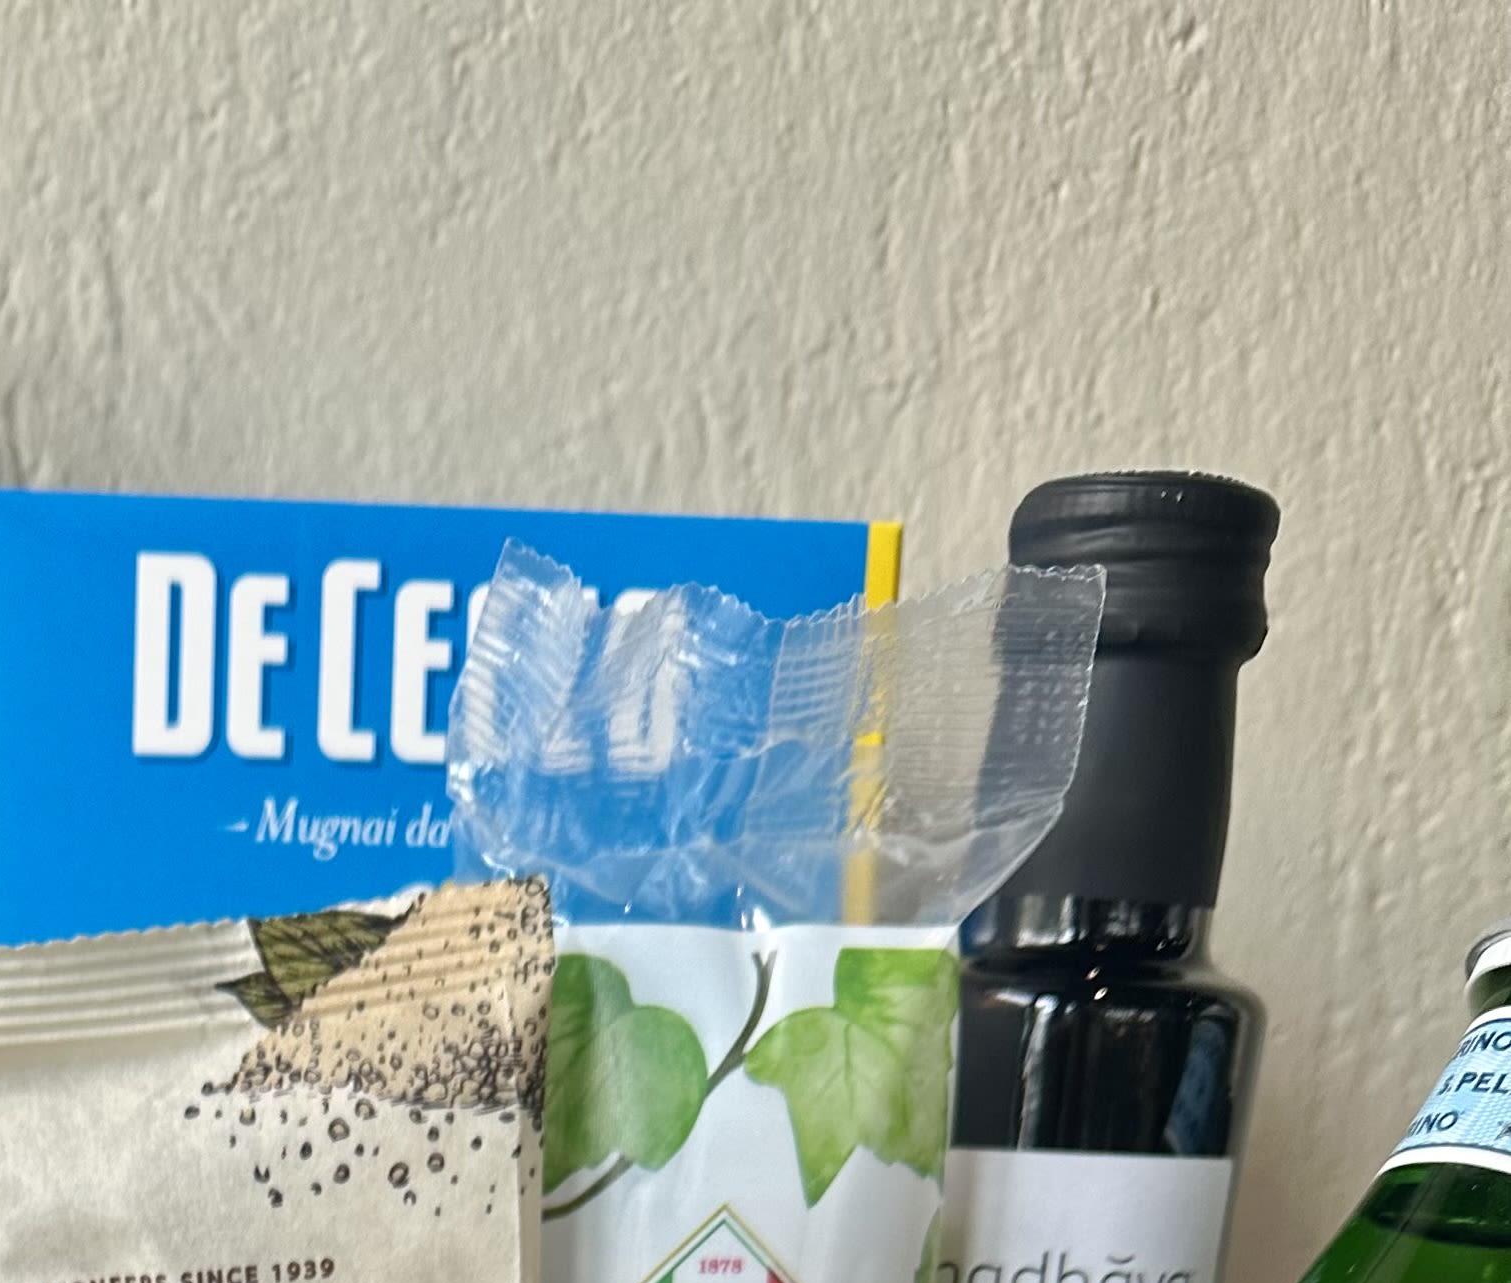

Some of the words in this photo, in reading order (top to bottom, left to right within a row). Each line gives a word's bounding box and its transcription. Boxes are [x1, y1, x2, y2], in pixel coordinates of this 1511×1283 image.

[255, 797, 397, 862] Mugnai
[405, 804, 451, 848] da
[272, 1257, 336, 1283] 1939
[698, 1259, 744, 1275] 1878
